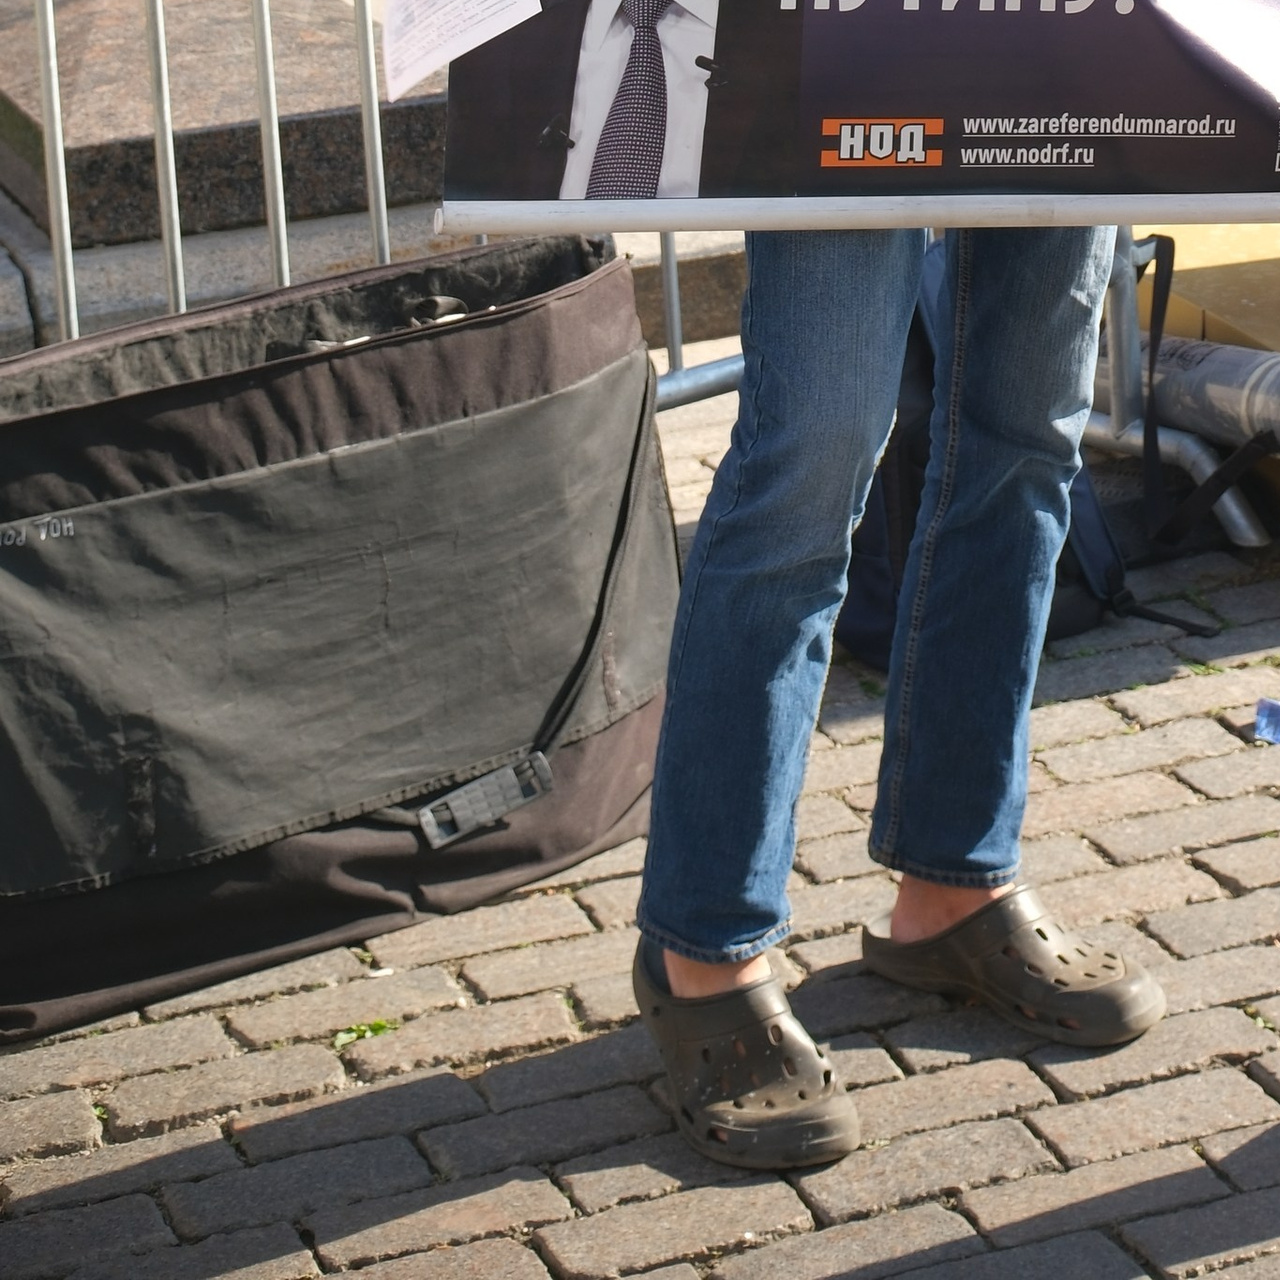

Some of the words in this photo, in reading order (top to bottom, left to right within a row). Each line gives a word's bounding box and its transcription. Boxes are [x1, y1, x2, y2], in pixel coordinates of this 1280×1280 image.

[962, 112, 1236, 136] www.zareferendumnarod.ru
[838, 122, 928, 164] НОД
[960, 142, 1095, 165] www.nodrf.ru
